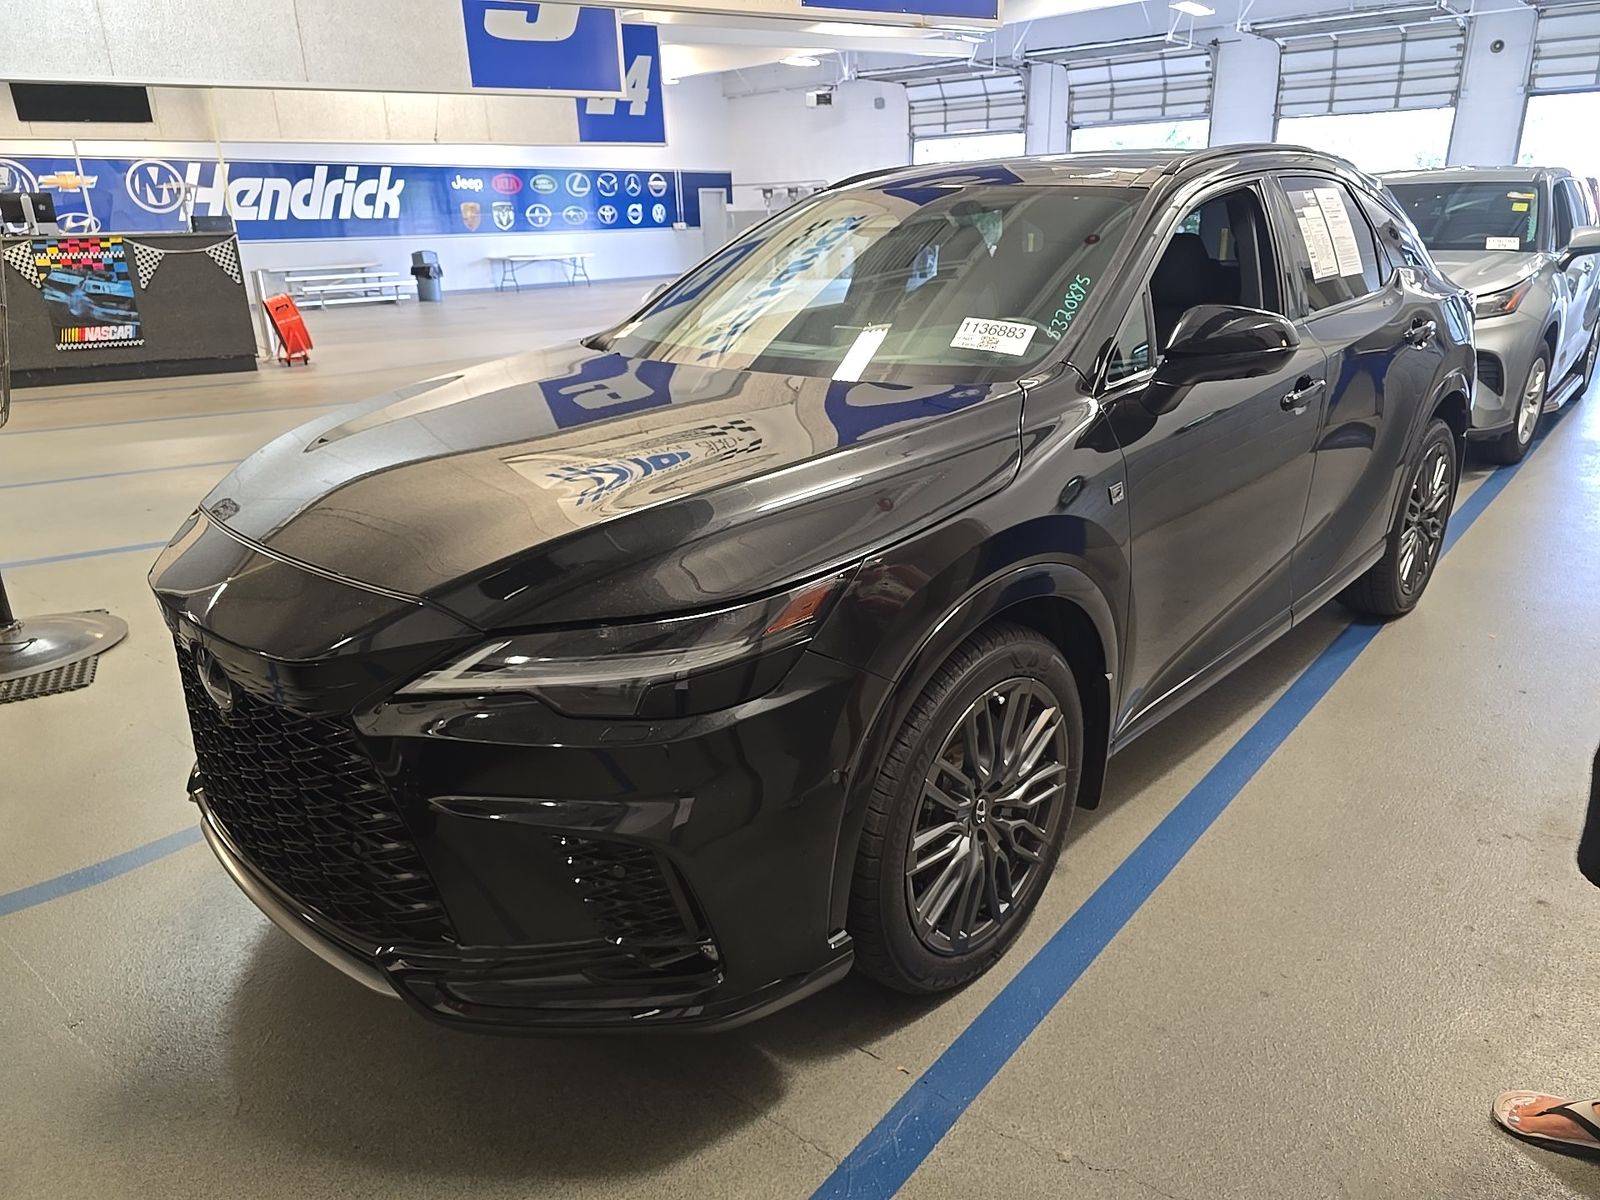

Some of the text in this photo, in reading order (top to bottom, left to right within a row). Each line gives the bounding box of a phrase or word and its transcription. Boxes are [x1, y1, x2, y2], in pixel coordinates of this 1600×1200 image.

[585, 55, 652, 116] 4
[178, 162, 405, 222] Hendrick
[451, 174, 484, 193] Jeep
[84, 325, 133, 342] NASCAR
[963, 321, 1027, 340] 1136883
